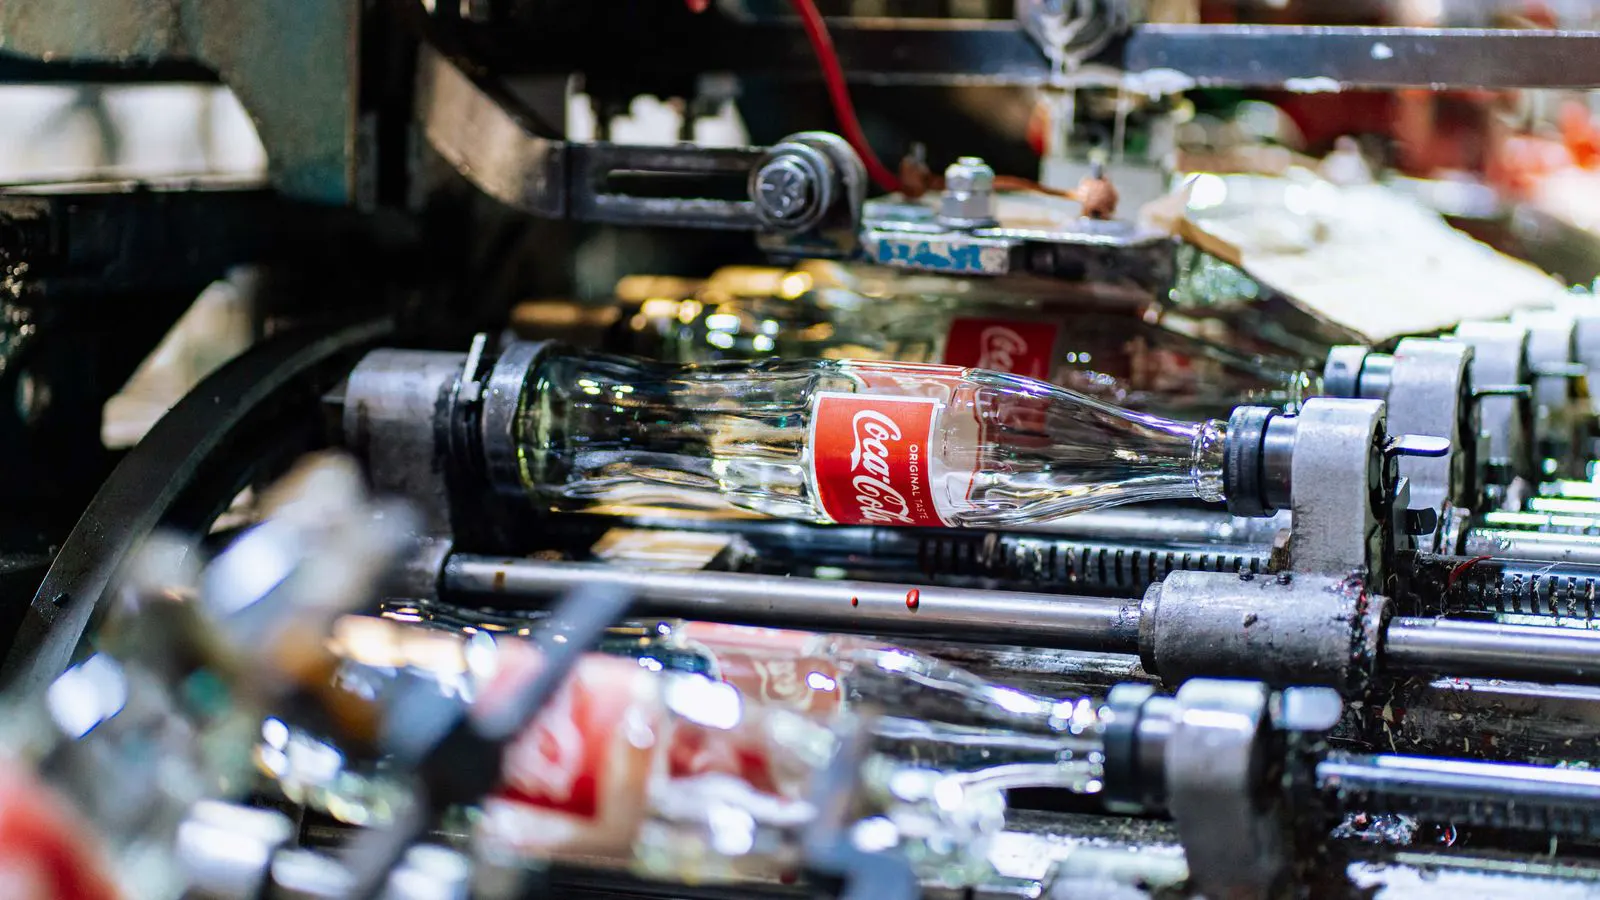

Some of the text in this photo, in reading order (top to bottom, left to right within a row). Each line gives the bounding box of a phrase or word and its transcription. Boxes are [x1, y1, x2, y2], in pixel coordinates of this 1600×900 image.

[851, 410, 916, 524] Coca-Cola
[909, 444, 929, 520] ORIGINAL TASTE
